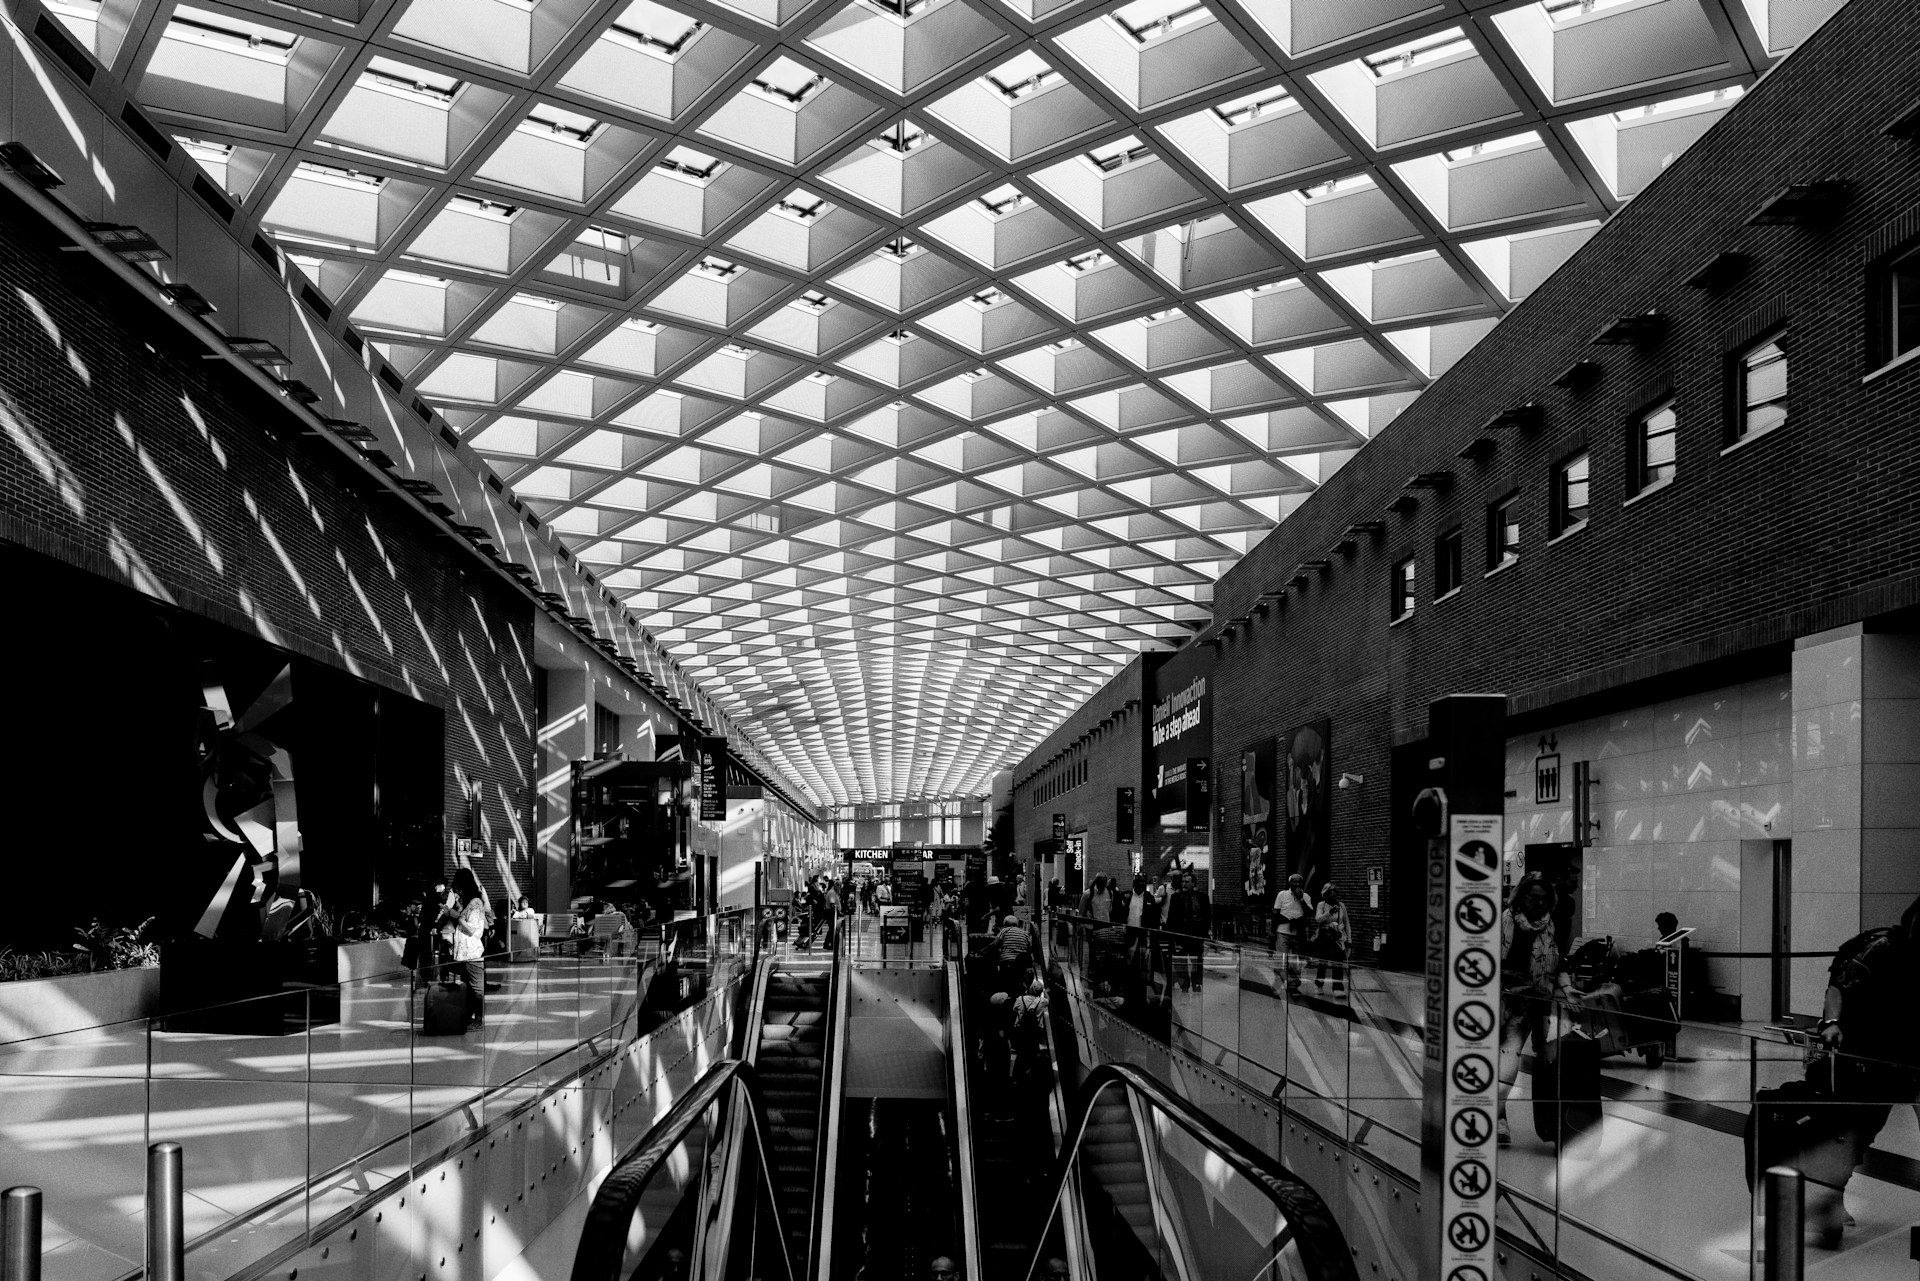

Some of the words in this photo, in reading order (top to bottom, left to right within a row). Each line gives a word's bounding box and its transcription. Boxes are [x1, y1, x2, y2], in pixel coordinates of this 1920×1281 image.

[1152, 725, 1158, 747] To
[1158, 723, 1165, 744] be
[1165, 723, 1170, 740] a
[1170, 715, 1182, 740] step
[1182, 700, 1200, 732] ahead
[854, 849, 889, 859] KITCHEN
[922, 850, 933, 859] AR
[1066, 840, 1074, 853] Self
[1074, 840, 1082, 870] Check-in
[1429, 846, 1445, 908] STOP
[1426, 913, 1443, 1061] EMERGENCY
